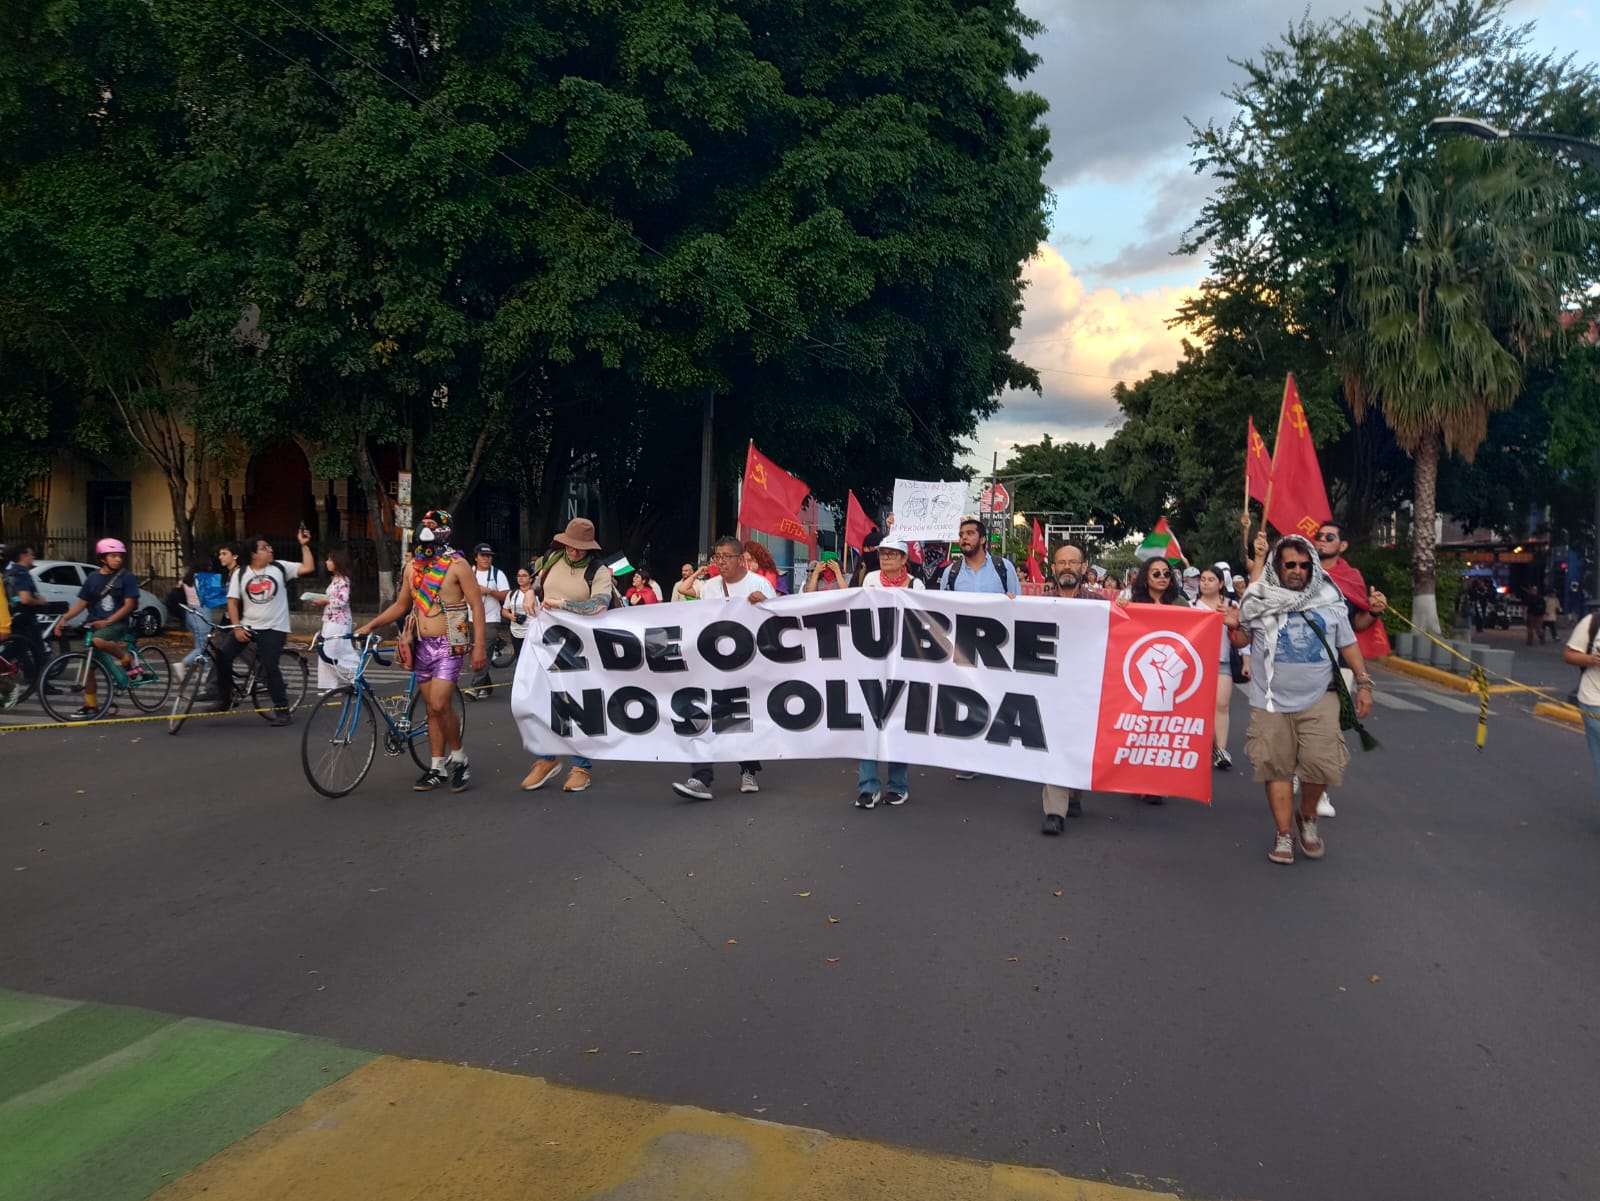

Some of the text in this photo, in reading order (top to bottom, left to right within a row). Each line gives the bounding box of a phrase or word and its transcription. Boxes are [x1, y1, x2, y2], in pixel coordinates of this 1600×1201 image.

[542, 606, 1060, 677] 2 DE OCTUBRE
[550, 679, 1049, 752] NO SE OLVIDA
[1113, 712, 1205, 736] JUSTICIA
[1125, 732, 1191, 749] PARA EL
[1113, 746, 1199, 769] PUEBLO
